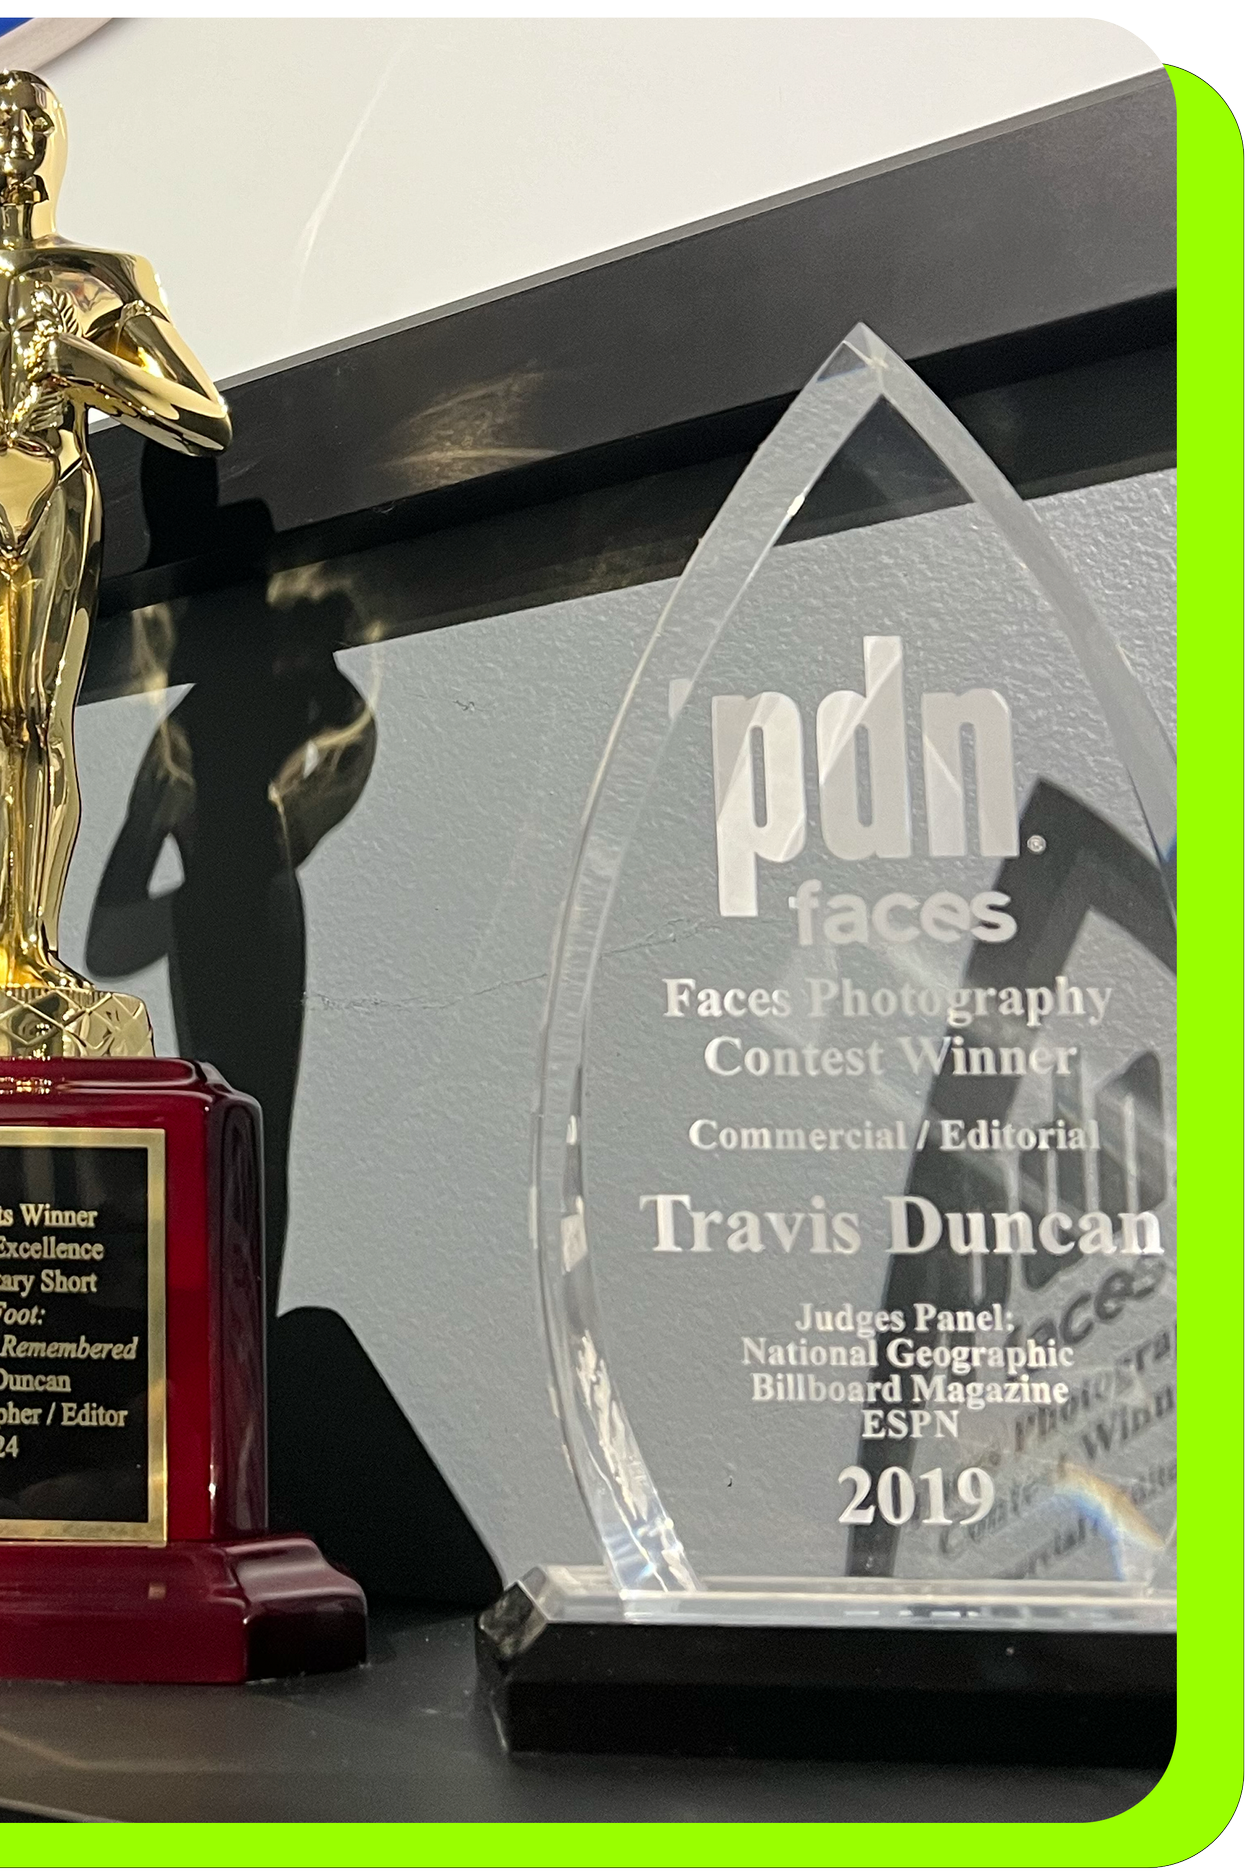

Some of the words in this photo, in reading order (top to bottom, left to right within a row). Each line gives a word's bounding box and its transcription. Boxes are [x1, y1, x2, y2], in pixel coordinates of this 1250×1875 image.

[712, 636, 1020, 917] pdn
[790, 880, 1018, 945] faces
[663, 979, 792, 1018] Faces
[807, 976, 1113, 1027] Photography
[705, 1036, 885, 1077] Contest
[897, 1037, 1078, 1077] Winner
[688, 1120, 908, 1152] Commercial
[916, 1121, 930, 1150] /
[939, 1120, 1101, 1151] Editorial
[20, 1204, 98, 1228] Winner
[639, 1195, 862, 1254] Travis
[883, 1196, 1164, 1255] Duncan
[41, 1269, 98, 1293] Short
[795, 1304, 905, 1337] Judges
[915, 1304, 1015, 1332] Panel:
[0, 1335, 139, 1360] Remembered
[742, 1338, 878, 1367] National
[887, 1339, 1074, 1375] Geographic
[751, 1374, 901, 1403] Billboard
[912, 1374, 1069, 1410] Magazine
[46, 1402, 57, 1426] /
[61, 1403, 128, 1427] Editor
[863, 1409, 960, 1440] ESPN
[838, 1467, 995, 1526] 2019
